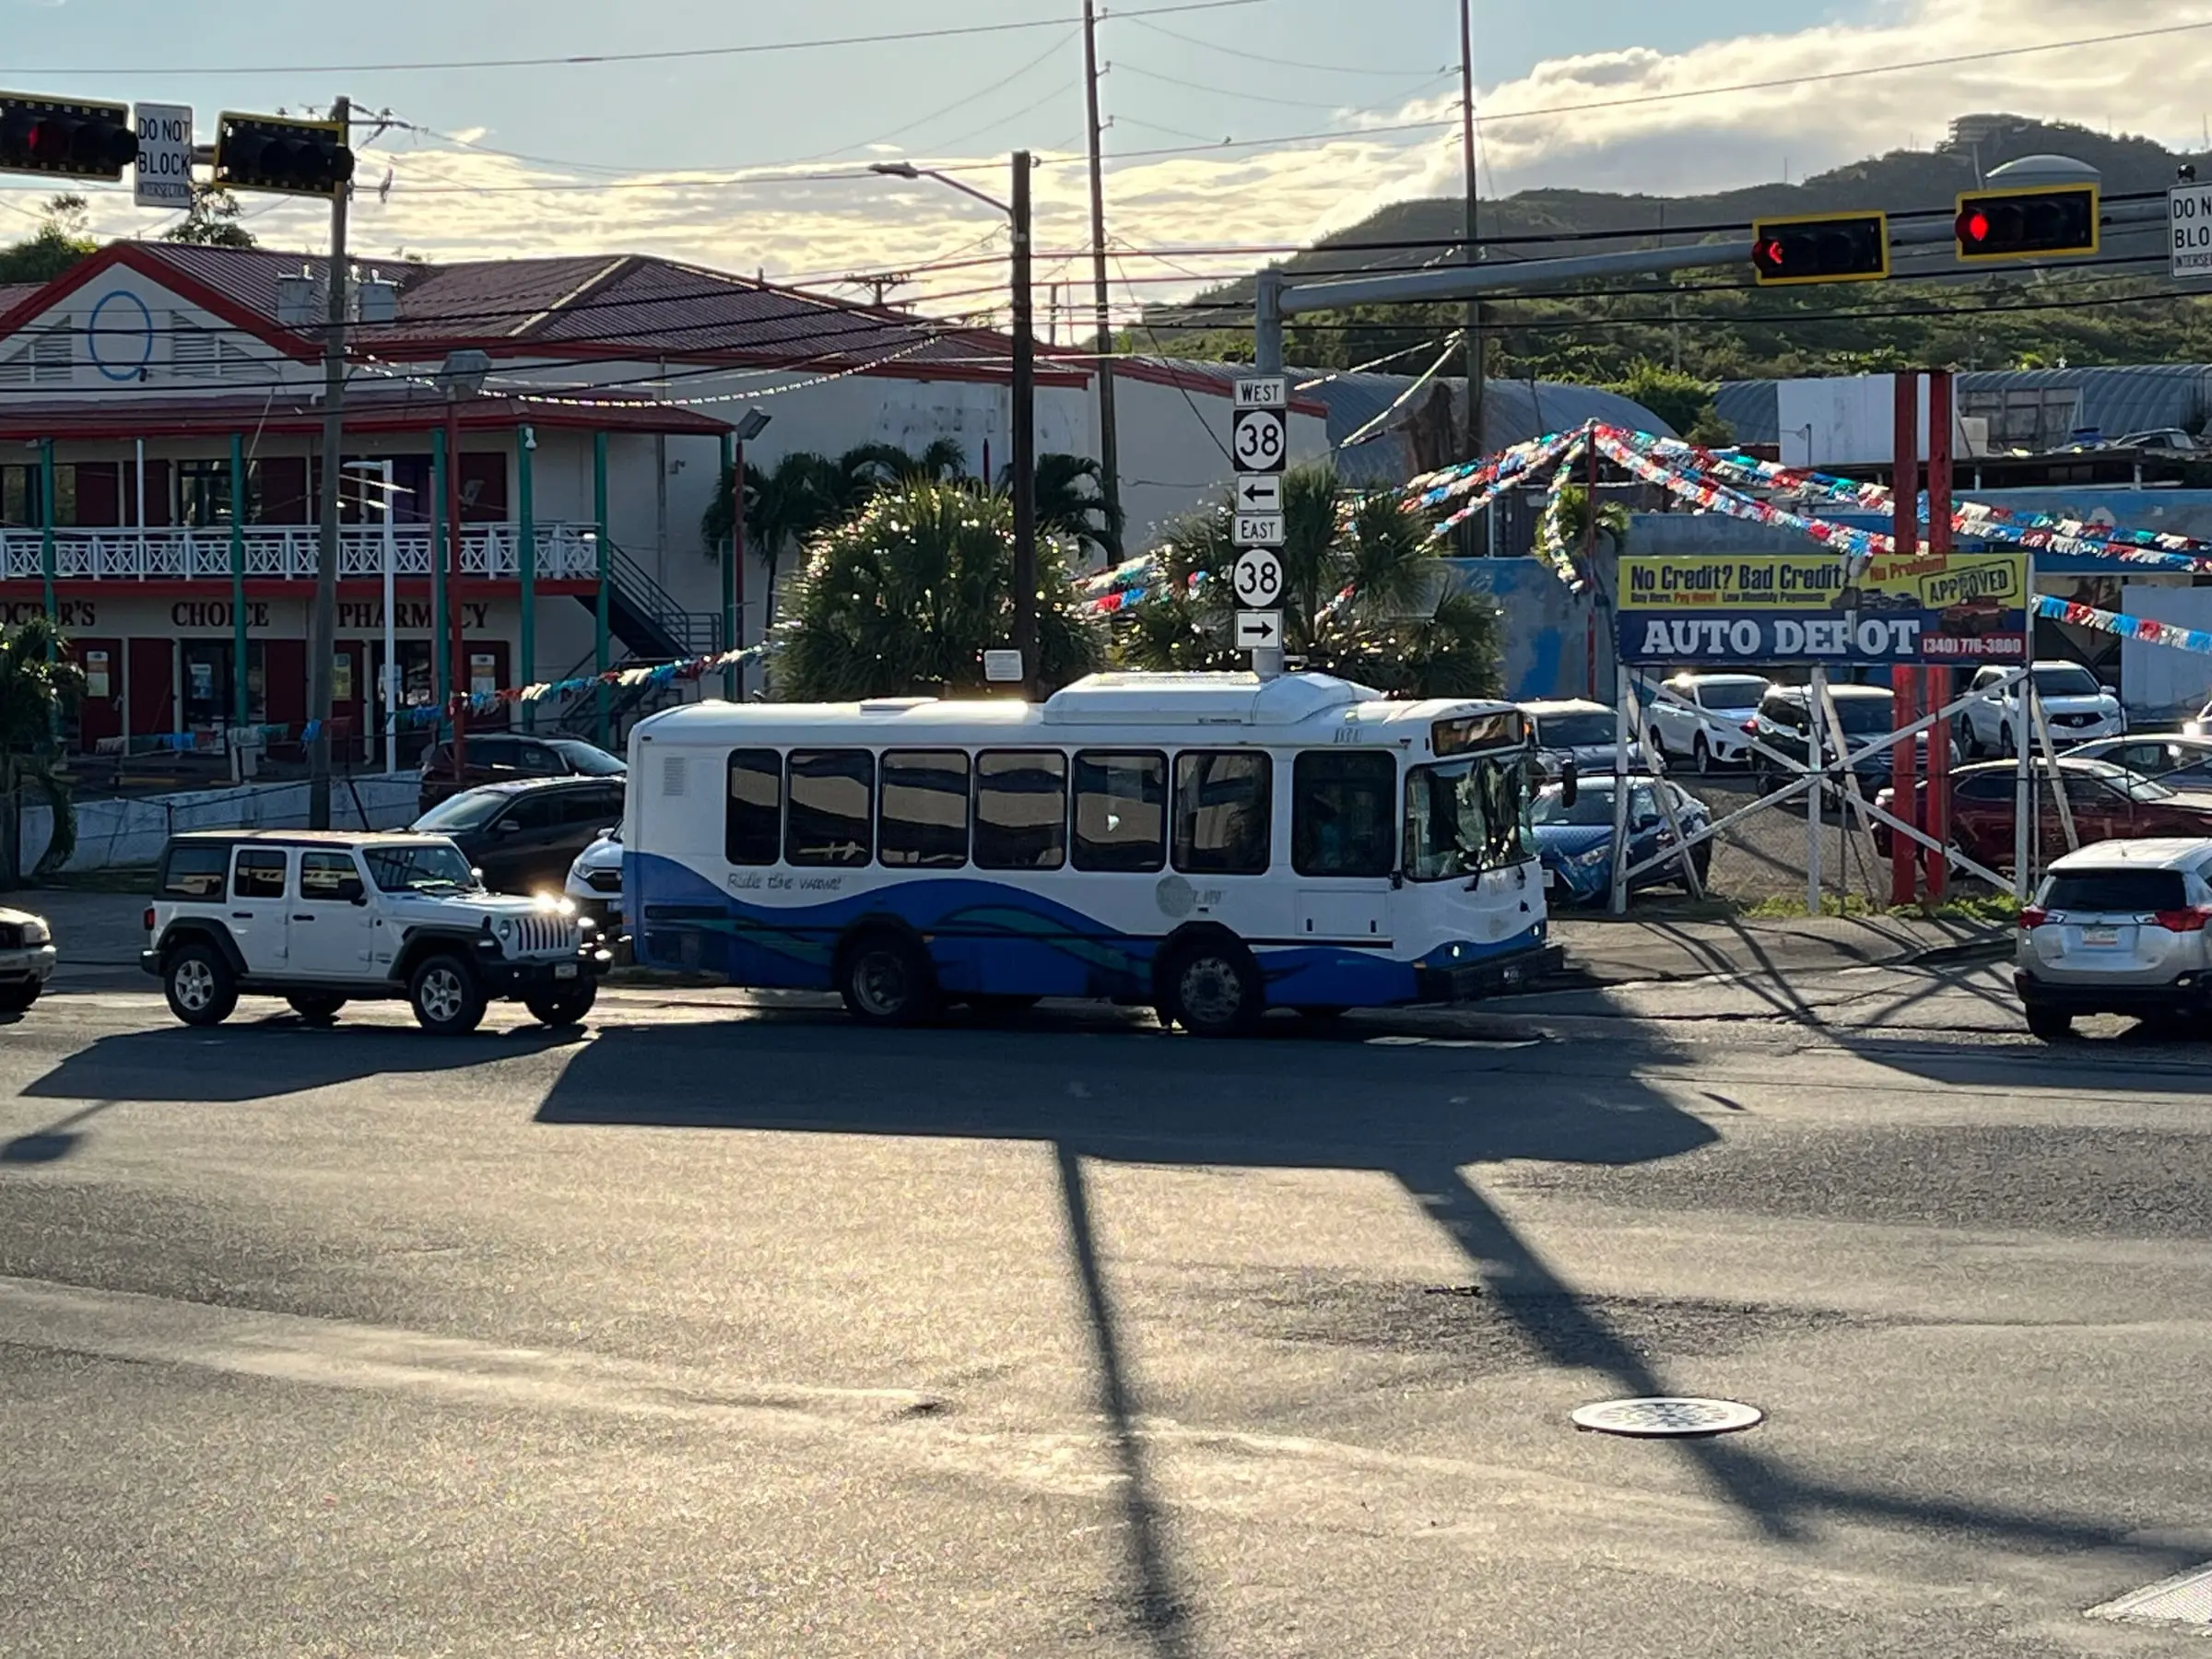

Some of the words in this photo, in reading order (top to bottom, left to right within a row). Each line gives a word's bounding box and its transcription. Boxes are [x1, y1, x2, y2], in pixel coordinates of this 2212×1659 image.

[138, 117, 158, 141] DO
[162, 120, 191, 142] NOT
[138, 151, 191, 176] BLOCK
[2173, 197, 2195, 218] DO
[2174, 225, 2210, 249] BLO
[1241, 383, 1279, 402] WEST
[1240, 424, 1279, 456] 38
[1241, 519, 1276, 539] EAST
[1239, 560, 1277, 594] 38
[1630, 565, 1655, 591] No
[1661, 565, 1733, 591] Credit?
[1738, 563, 1775, 590] Bad
[1779, 563, 1841, 590] Credit
[1929, 568, 2008, 603] APPROVED
[337, 602, 489, 628] PHARMCY
[1641, 619, 1761, 654] AUTO
[1773, 618, 1921, 655] DEPOT
